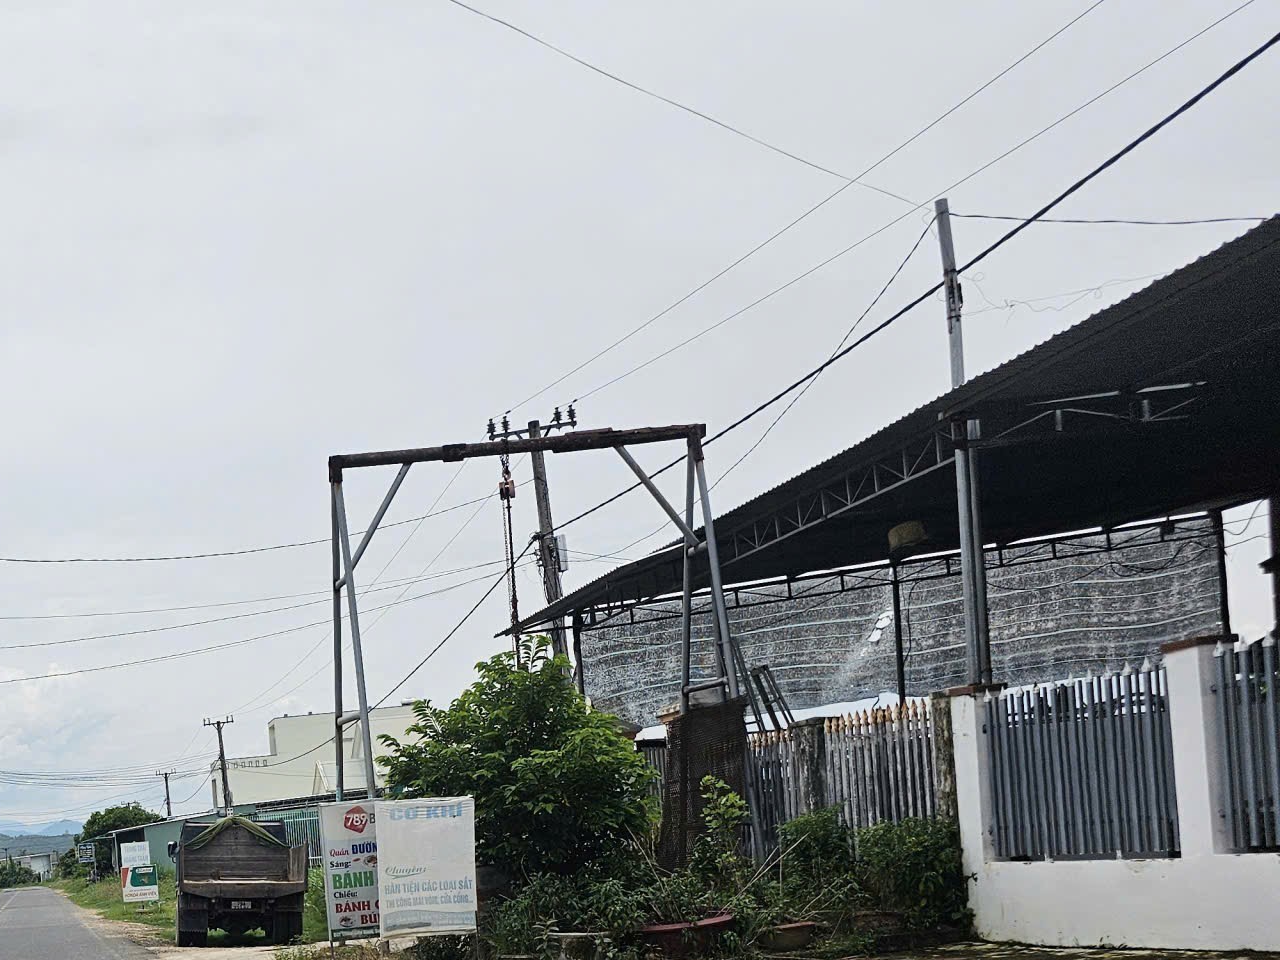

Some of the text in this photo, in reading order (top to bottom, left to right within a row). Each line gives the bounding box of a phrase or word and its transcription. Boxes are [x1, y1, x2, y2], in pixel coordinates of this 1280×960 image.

[346, 813, 367, 825] 789
[330, 861, 351, 869] Sáng:
[332, 871, 374, 889] BÁNH
[336, 900, 371, 913] BÁNH
